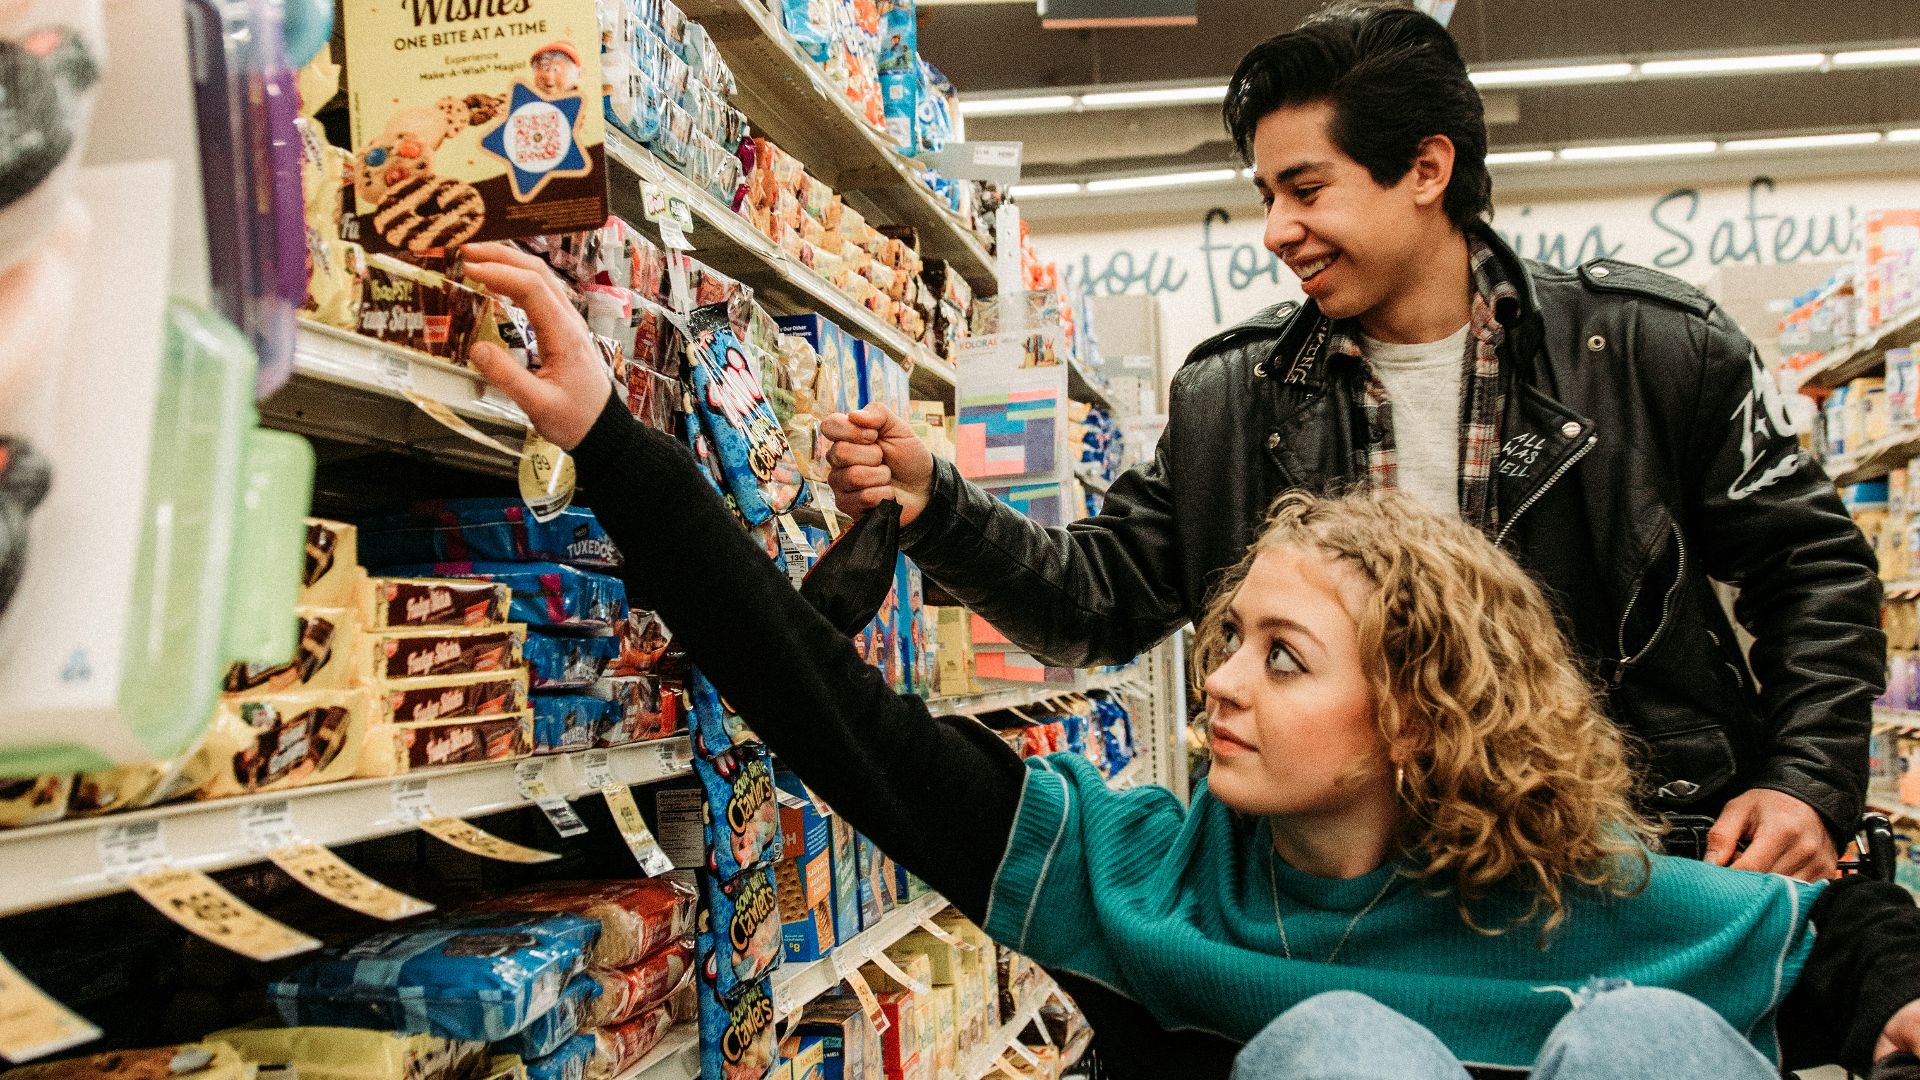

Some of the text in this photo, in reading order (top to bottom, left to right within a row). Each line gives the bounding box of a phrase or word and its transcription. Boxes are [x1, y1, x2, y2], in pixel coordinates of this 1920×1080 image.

[394, 20, 547, 51] ONE BITE AT A TIME
[444, 52, 499, 65] Experience
[1501, 440, 1539, 464] WAS
[1512, 432, 1546, 450] ALL
[566, 539, 616, 560] TUXEDOS
[728, 775, 772, 833] Crawlers
[730, 886, 775, 951] Crawlers
[723, 998, 773, 1060] Crawlers
